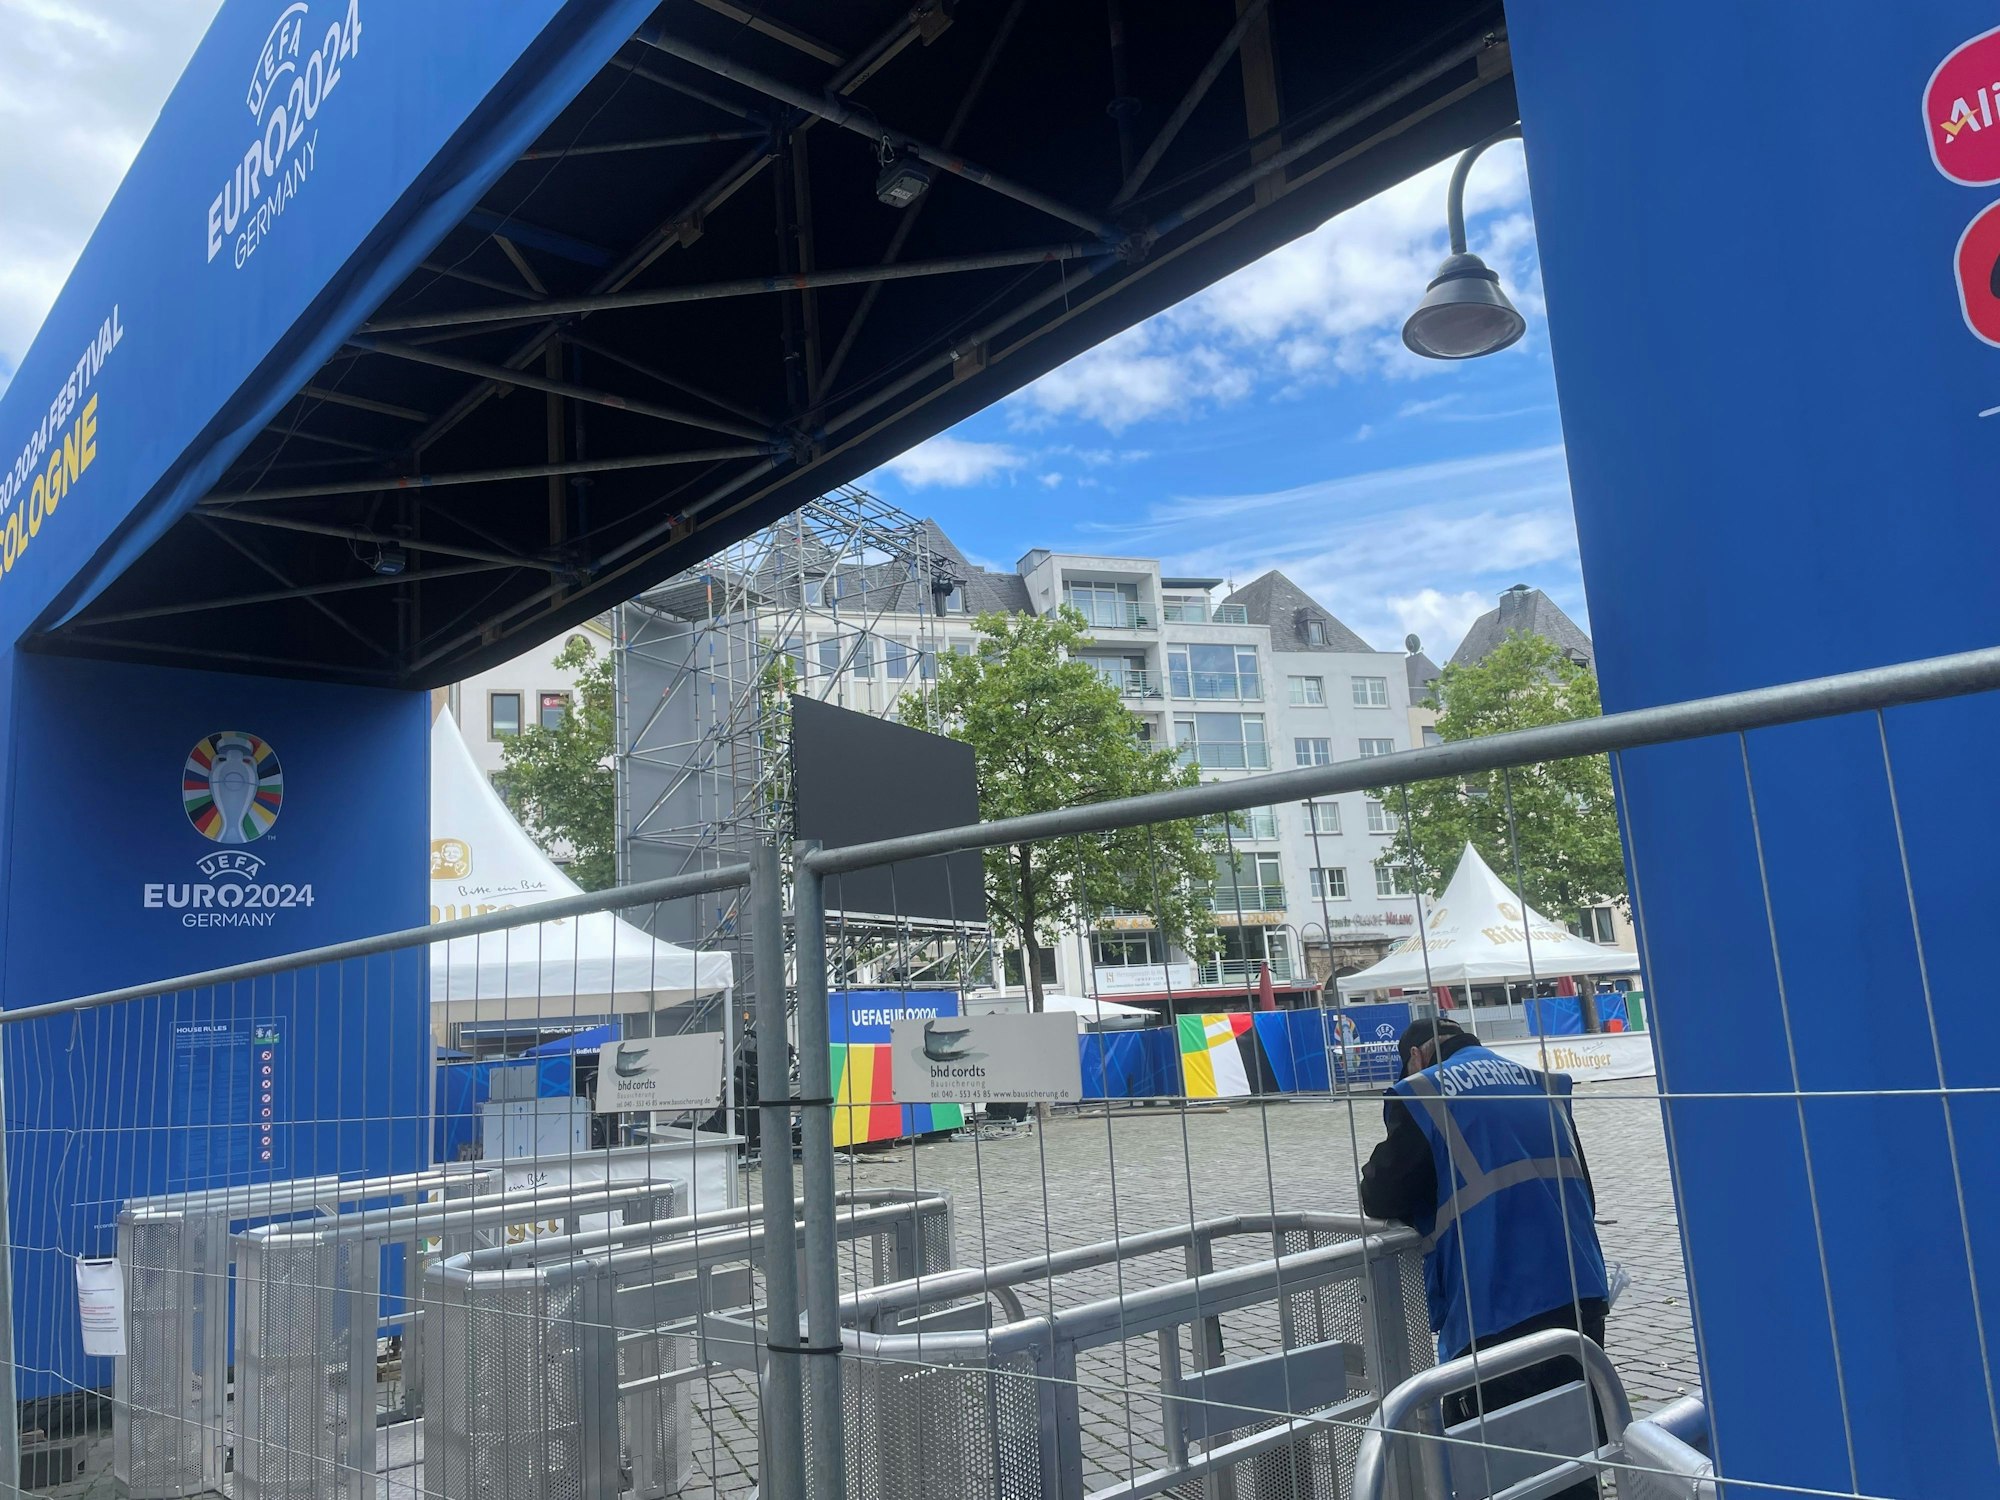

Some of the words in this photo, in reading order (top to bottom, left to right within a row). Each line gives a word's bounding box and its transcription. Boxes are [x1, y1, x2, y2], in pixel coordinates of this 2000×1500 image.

[250, 18, 302, 116] UEFA
[234, 128, 319, 270] GERMANY
[13, 415, 48, 498] 2024
[48, 303, 124, 444] FESTIVAL
[200, 855, 260, 877] UEFA
[182, 912, 276, 928] GERMANY
[1481, 924, 1574, 945] Bitburger
[176, 1026, 202, 1034] HOUSE
[1376, 1026, 1394, 1037] UEFA
[1553, 1047, 1611, 1070] Bitburger
[930, 1065, 949, 1077] bhd
[951, 1064, 986, 1077] cordts
[618, 1080, 631, 1091] bhd
[633, 1078, 656, 1090] cordts
[930, 1079, 986, 1089] Bausicherung
[941, 1090, 953, 1099] 040
[959, 1090, 971, 1098] 553
[973, 1089, 981, 1098] 45
[983, 1089, 991, 1098] 85
[993, 1089, 1069, 1100] www.bausicherung.de
